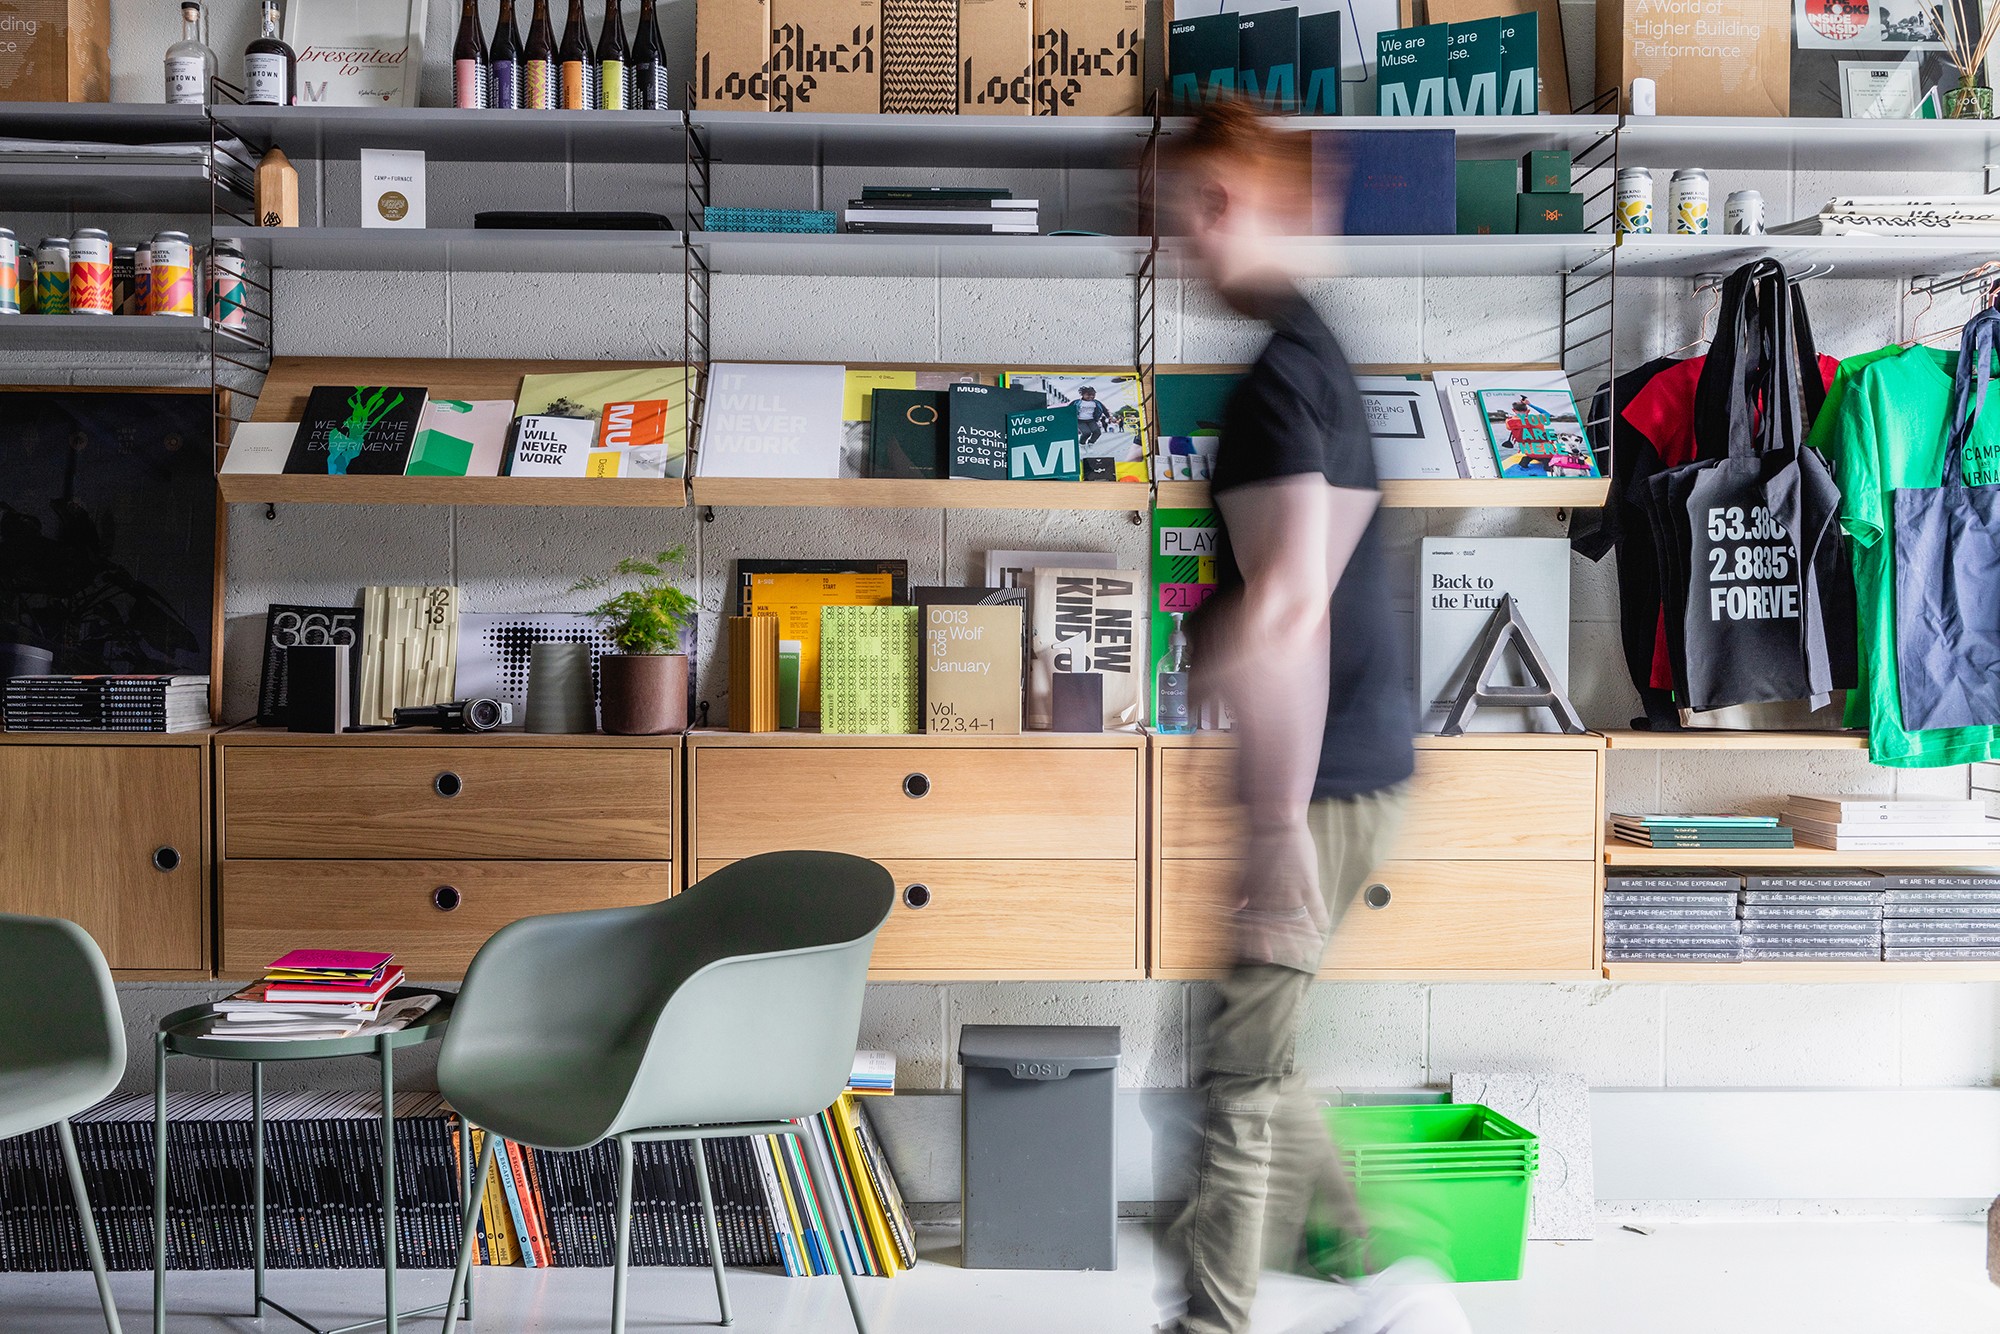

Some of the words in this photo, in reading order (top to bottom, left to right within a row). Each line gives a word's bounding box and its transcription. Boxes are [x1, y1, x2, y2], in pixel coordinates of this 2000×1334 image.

[1635, 0, 1648, 13] A
[1655, 0, 1701, 14] World
[1706, 0, 1724, 14] of
[1239, 21, 1255, 30] use
[1634, 20, 1691, 39] Higher
[1695, 20, 1761, 39] Building
[1457, 32, 1478, 43] are
[1501, 28, 1515, 39] re
[1381, 39, 1402, 52] We
[1405, 37, 1425, 49] are
[1634, 41, 1741, 57] Performance
[296, 46, 409, 64] presented
[1381, 53, 1418, 67] Muse.
[1448, 49, 1470, 61] use.
[339, 63, 364, 76] to
[1381, 76, 1444, 116] M
[722, 374, 747, 390] IT
[720, 394, 787, 412] WILL
[314, 420, 337, 430] WE
[341, 420, 371, 430] ARE
[379, 420, 409, 431] THE
[526, 419, 539, 429] IT
[716, 414, 807, 433] NEVER
[1011, 416, 1031, 427] We
[1035, 414, 1055, 424] are
[1517, 414, 1551, 426] YOU
[524, 430, 558, 442] WILL
[957, 426, 966, 434] A
[971, 427, 1001, 438] book
[1012, 425, 1048, 436] Muse.
[1522, 428, 1558, 440] ARE
[307, 441, 402, 452] EXPERIMENT
[714, 435, 800, 454] WORK
[957, 435, 977, 445] the
[521, 441, 567, 454] NEVER
[957, 445, 973, 453] do
[978, 447, 991, 455] to
[1519, 442, 1569, 455] HERE
[1965, 445, 2000, 461] CAMP
[519, 452, 563, 465] WORK
[957, 455, 990, 466] great
[1011, 439, 1076, 478] M
[1963, 471, 2000, 486] URNA
[1165, 532, 1217, 551] PLAY
[1096, 577, 1133, 597] A
[1432, 574, 1472, 589] Back
[1477, 576, 1494, 589] to
[430, 588, 449, 606] 12
[1432, 594, 1458, 608] the
[1463, 594, 1518, 608] Futue
[1710, 585, 1799, 621] FOREVE
[425, 606, 444, 624] 13
[931, 609, 968, 624] 0013
[272, 612, 356, 649] 365
[928, 628, 945, 643] ng
[950, 627, 984, 640] Wolf
[1094, 609, 1132, 673] NEW
[932, 644, 947, 657] 13
[930, 659, 991, 675] January
[930, 702, 957, 715] Vol.
[1014, 1062, 1065, 1077] POST
[500, 1157, 513, 1188] ESCAPIST
